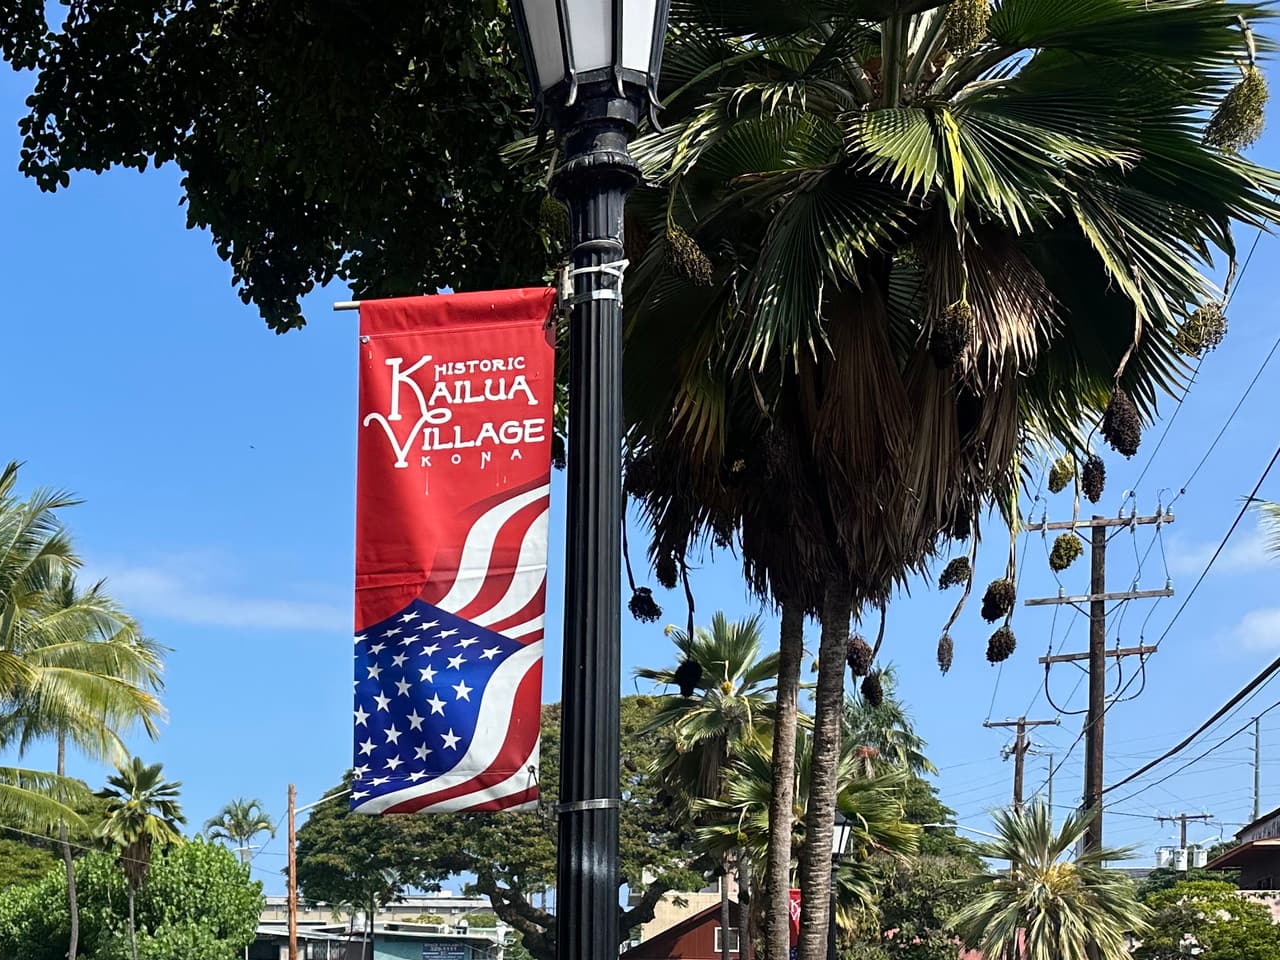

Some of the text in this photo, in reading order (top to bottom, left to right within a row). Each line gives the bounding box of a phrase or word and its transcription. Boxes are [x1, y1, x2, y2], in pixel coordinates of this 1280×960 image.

[384, 354, 539, 424] KAILUA
[434, 356, 526, 381] HISTORIC
[363, 411, 545, 468] VILLAGE
[421, 449, 522, 469] KONA
